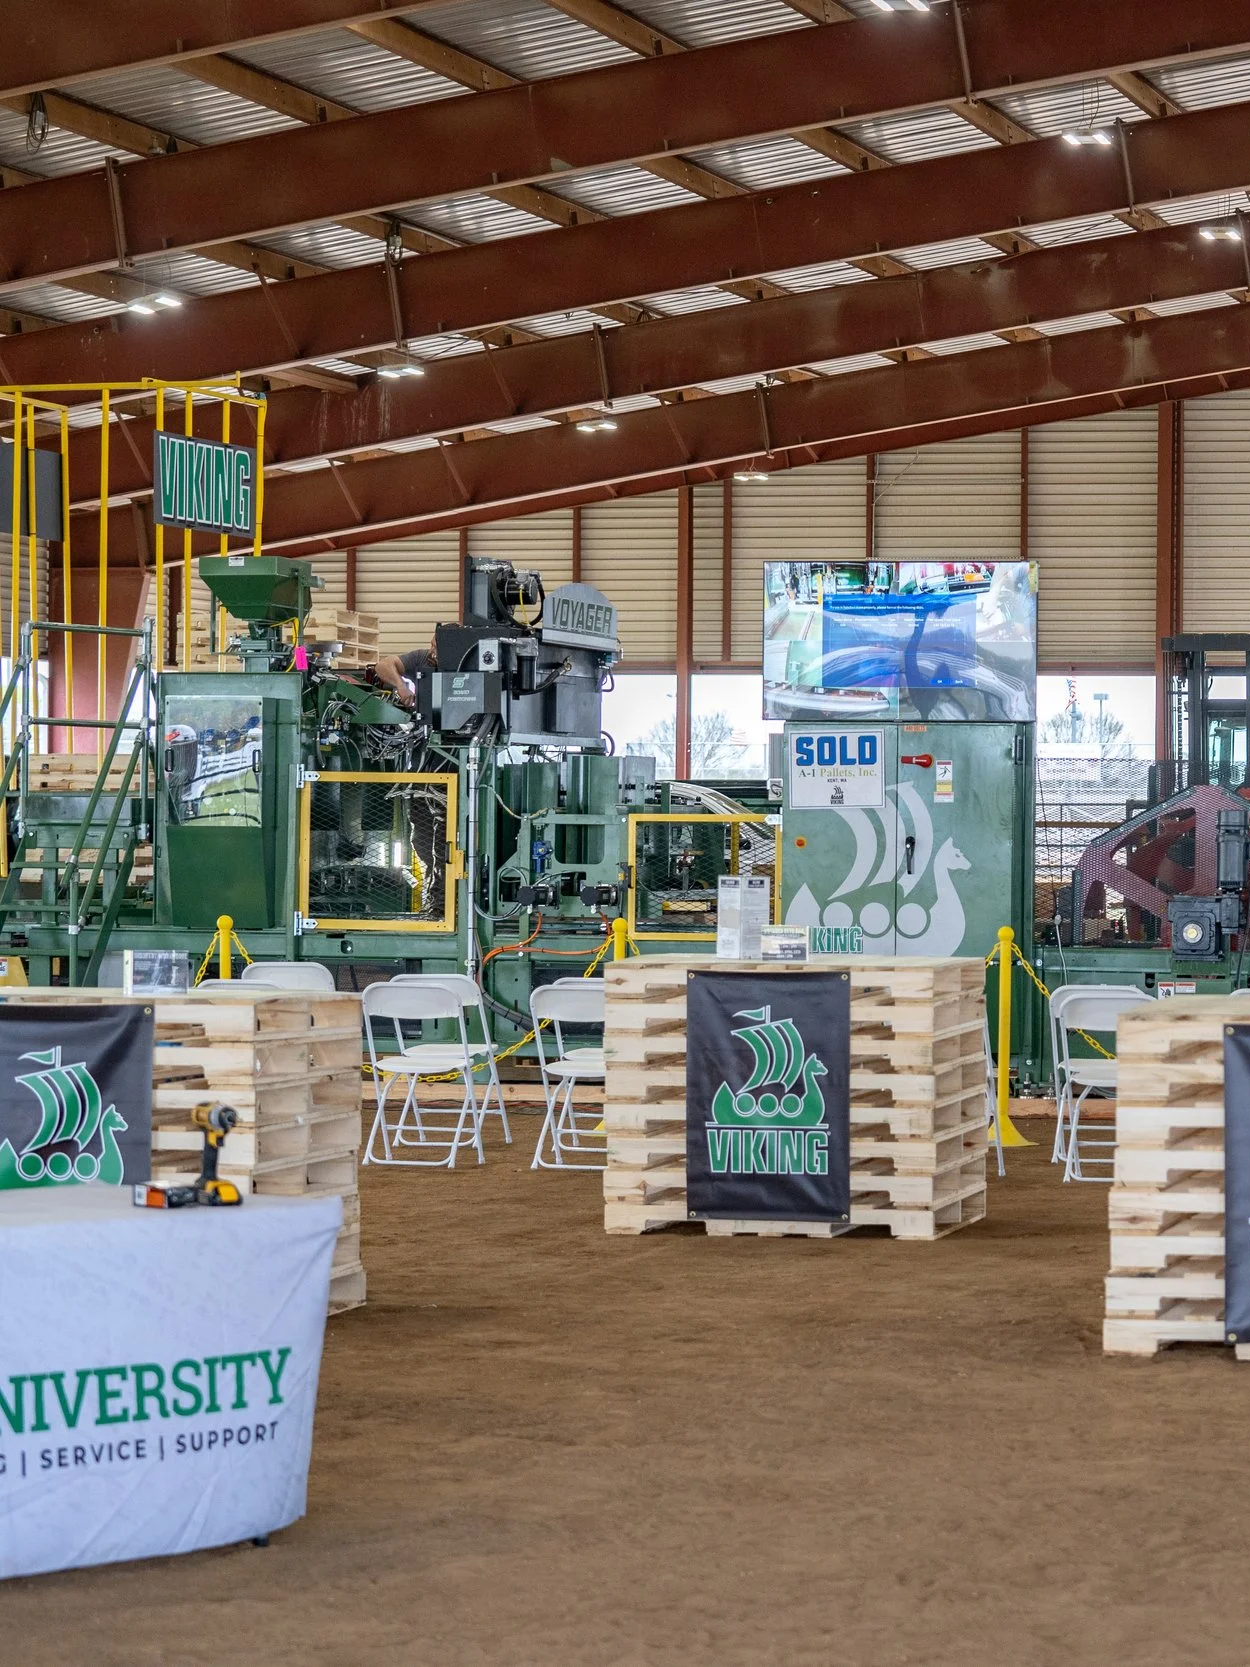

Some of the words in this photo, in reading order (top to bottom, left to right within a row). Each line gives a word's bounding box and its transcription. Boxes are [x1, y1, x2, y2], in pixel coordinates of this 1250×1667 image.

[159, 435, 251, 531] VIKING
[552, 597, 613, 635] VOYAGER
[795, 735, 878, 767] SOLD
[798, 768, 816, 778] A-1
[820, 767, 856, 778] Pallets,
[858, 767, 878, 777] Inc.
[811, 926, 864, 954] KING
[706, 1128, 829, 1175] VIKING
[40, 1438, 148, 1470] SERVICE
[175, 1421, 279, 1454] SUPPORT
